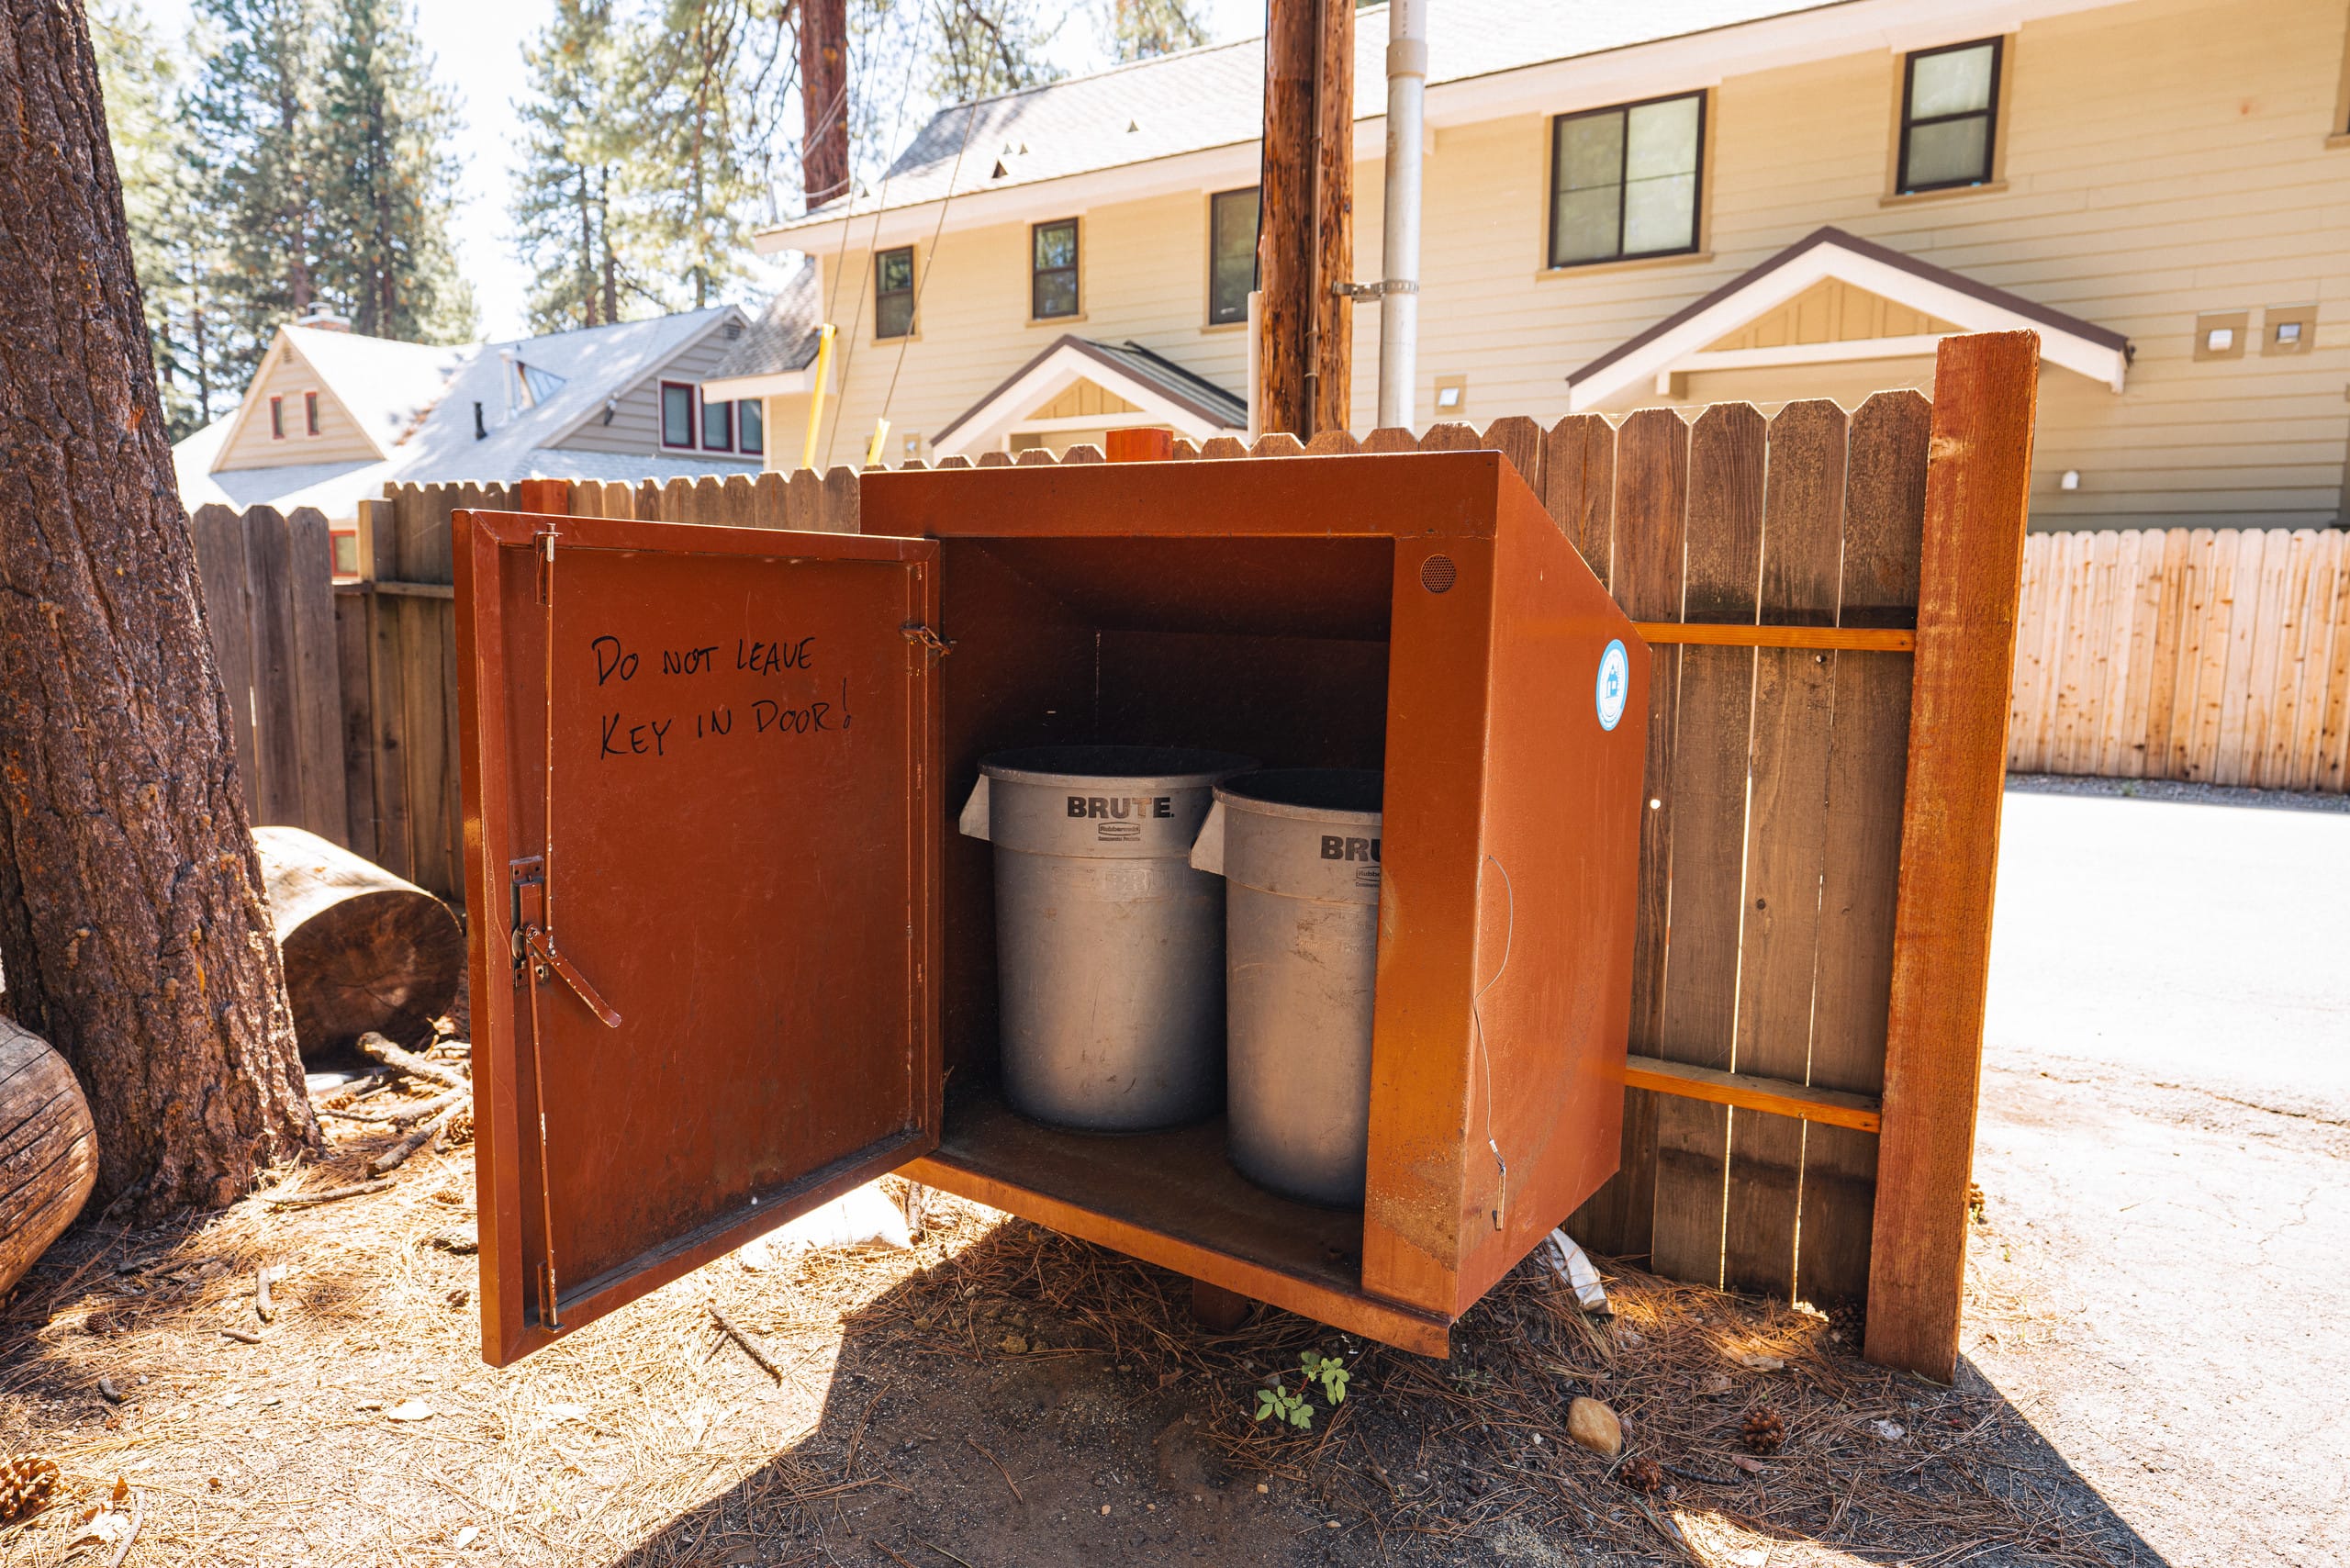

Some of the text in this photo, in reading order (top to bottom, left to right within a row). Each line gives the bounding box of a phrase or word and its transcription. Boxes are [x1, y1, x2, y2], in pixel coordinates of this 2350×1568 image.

[663, 646, 720, 675] NOT
[736, 637, 816, 676] LEAVE
[600, 712, 672, 760] KEY
[698, 710, 733, 738] IN
